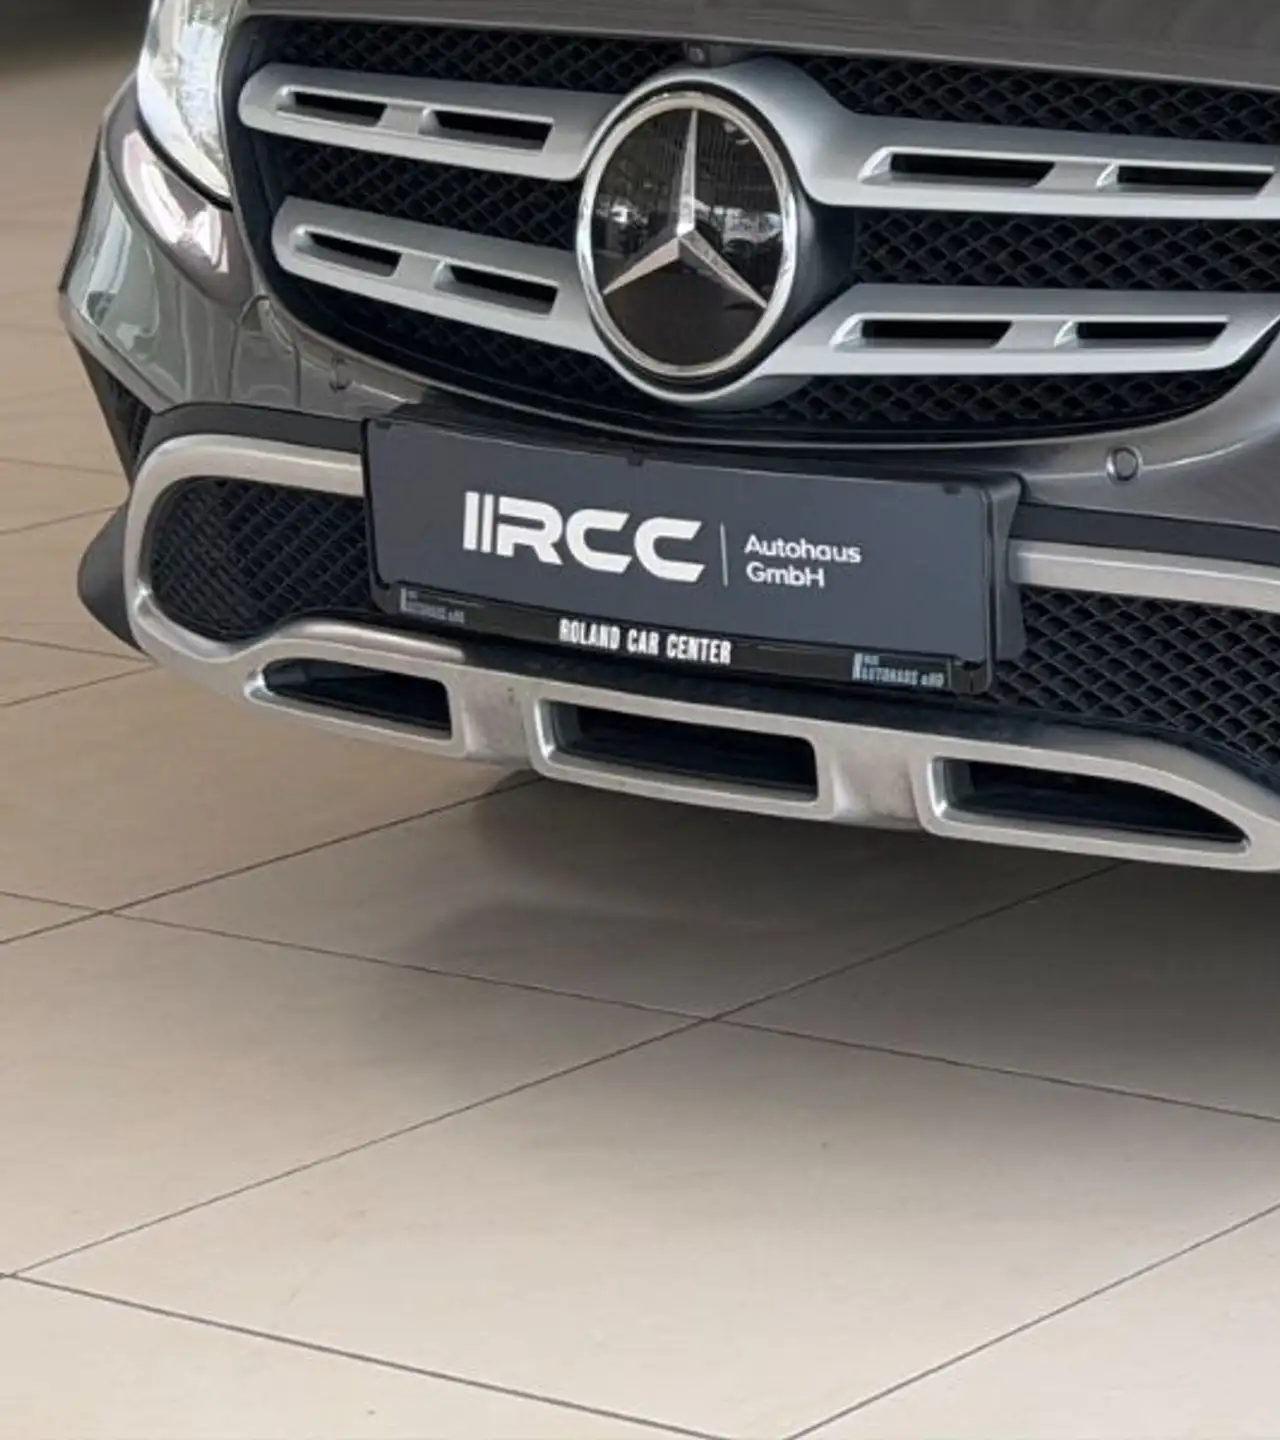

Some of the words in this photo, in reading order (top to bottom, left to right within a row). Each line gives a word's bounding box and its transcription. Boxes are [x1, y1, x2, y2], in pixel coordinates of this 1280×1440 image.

[744, 533, 862, 564] Autohaus
[745, 560, 825, 589] GmbH
[558, 617, 622, 651] ROLAND
[626, 627, 660, 657] CAR
[666, 633, 733, 667] CENTER
